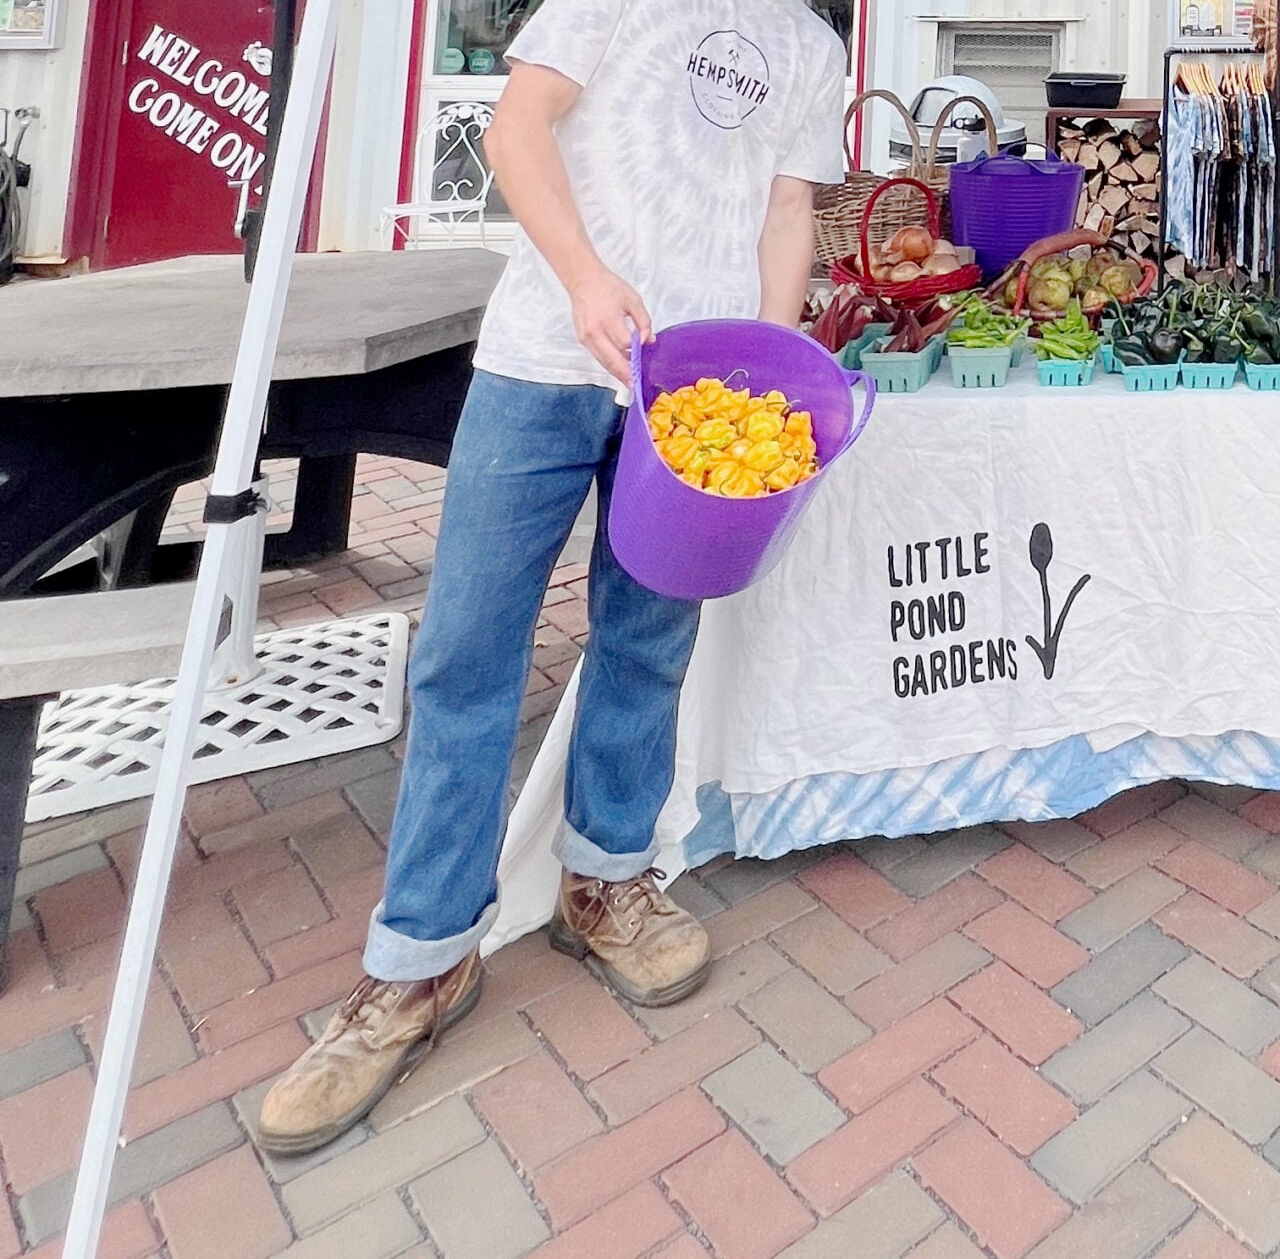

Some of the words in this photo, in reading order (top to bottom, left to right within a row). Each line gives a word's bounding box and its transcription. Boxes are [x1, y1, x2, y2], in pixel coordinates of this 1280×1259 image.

[686, 52, 770, 105] HEMPSMITH
[128, 78, 221, 154] COME
[887, 532, 991, 587] LITTLE
[890, 591, 966, 642] POND
[892, 637, 1018, 698] GARDENS
